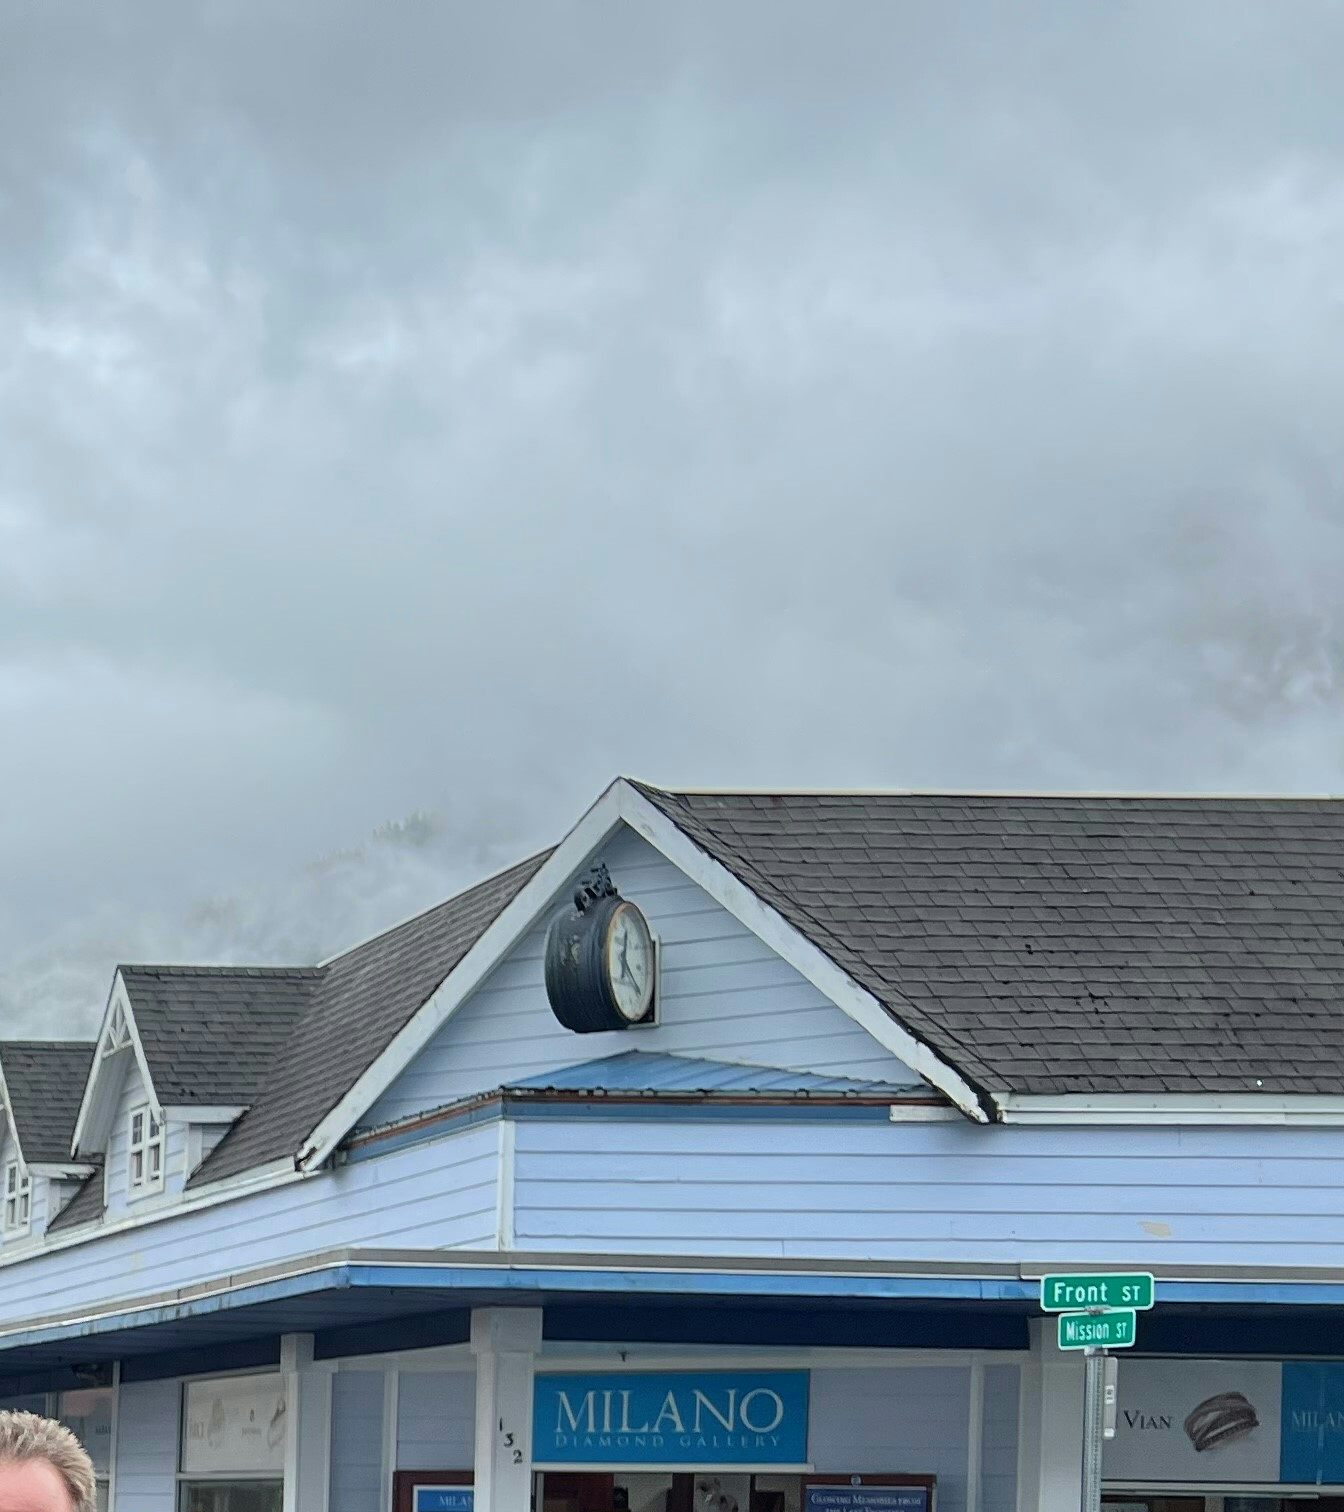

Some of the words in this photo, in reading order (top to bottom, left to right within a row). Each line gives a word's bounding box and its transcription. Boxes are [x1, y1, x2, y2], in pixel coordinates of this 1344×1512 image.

[1053, 1281, 1108, 1303] Front
[1121, 1285, 1141, 1302] ST
[1066, 1319, 1110, 1341] Mission
[1115, 1321, 1127, 1339] ST
[553, 1386, 785, 1434] MILANO
[553, 1434, 665, 1449] DIAMOND
[679, 1432, 783, 1448] GALLERY
